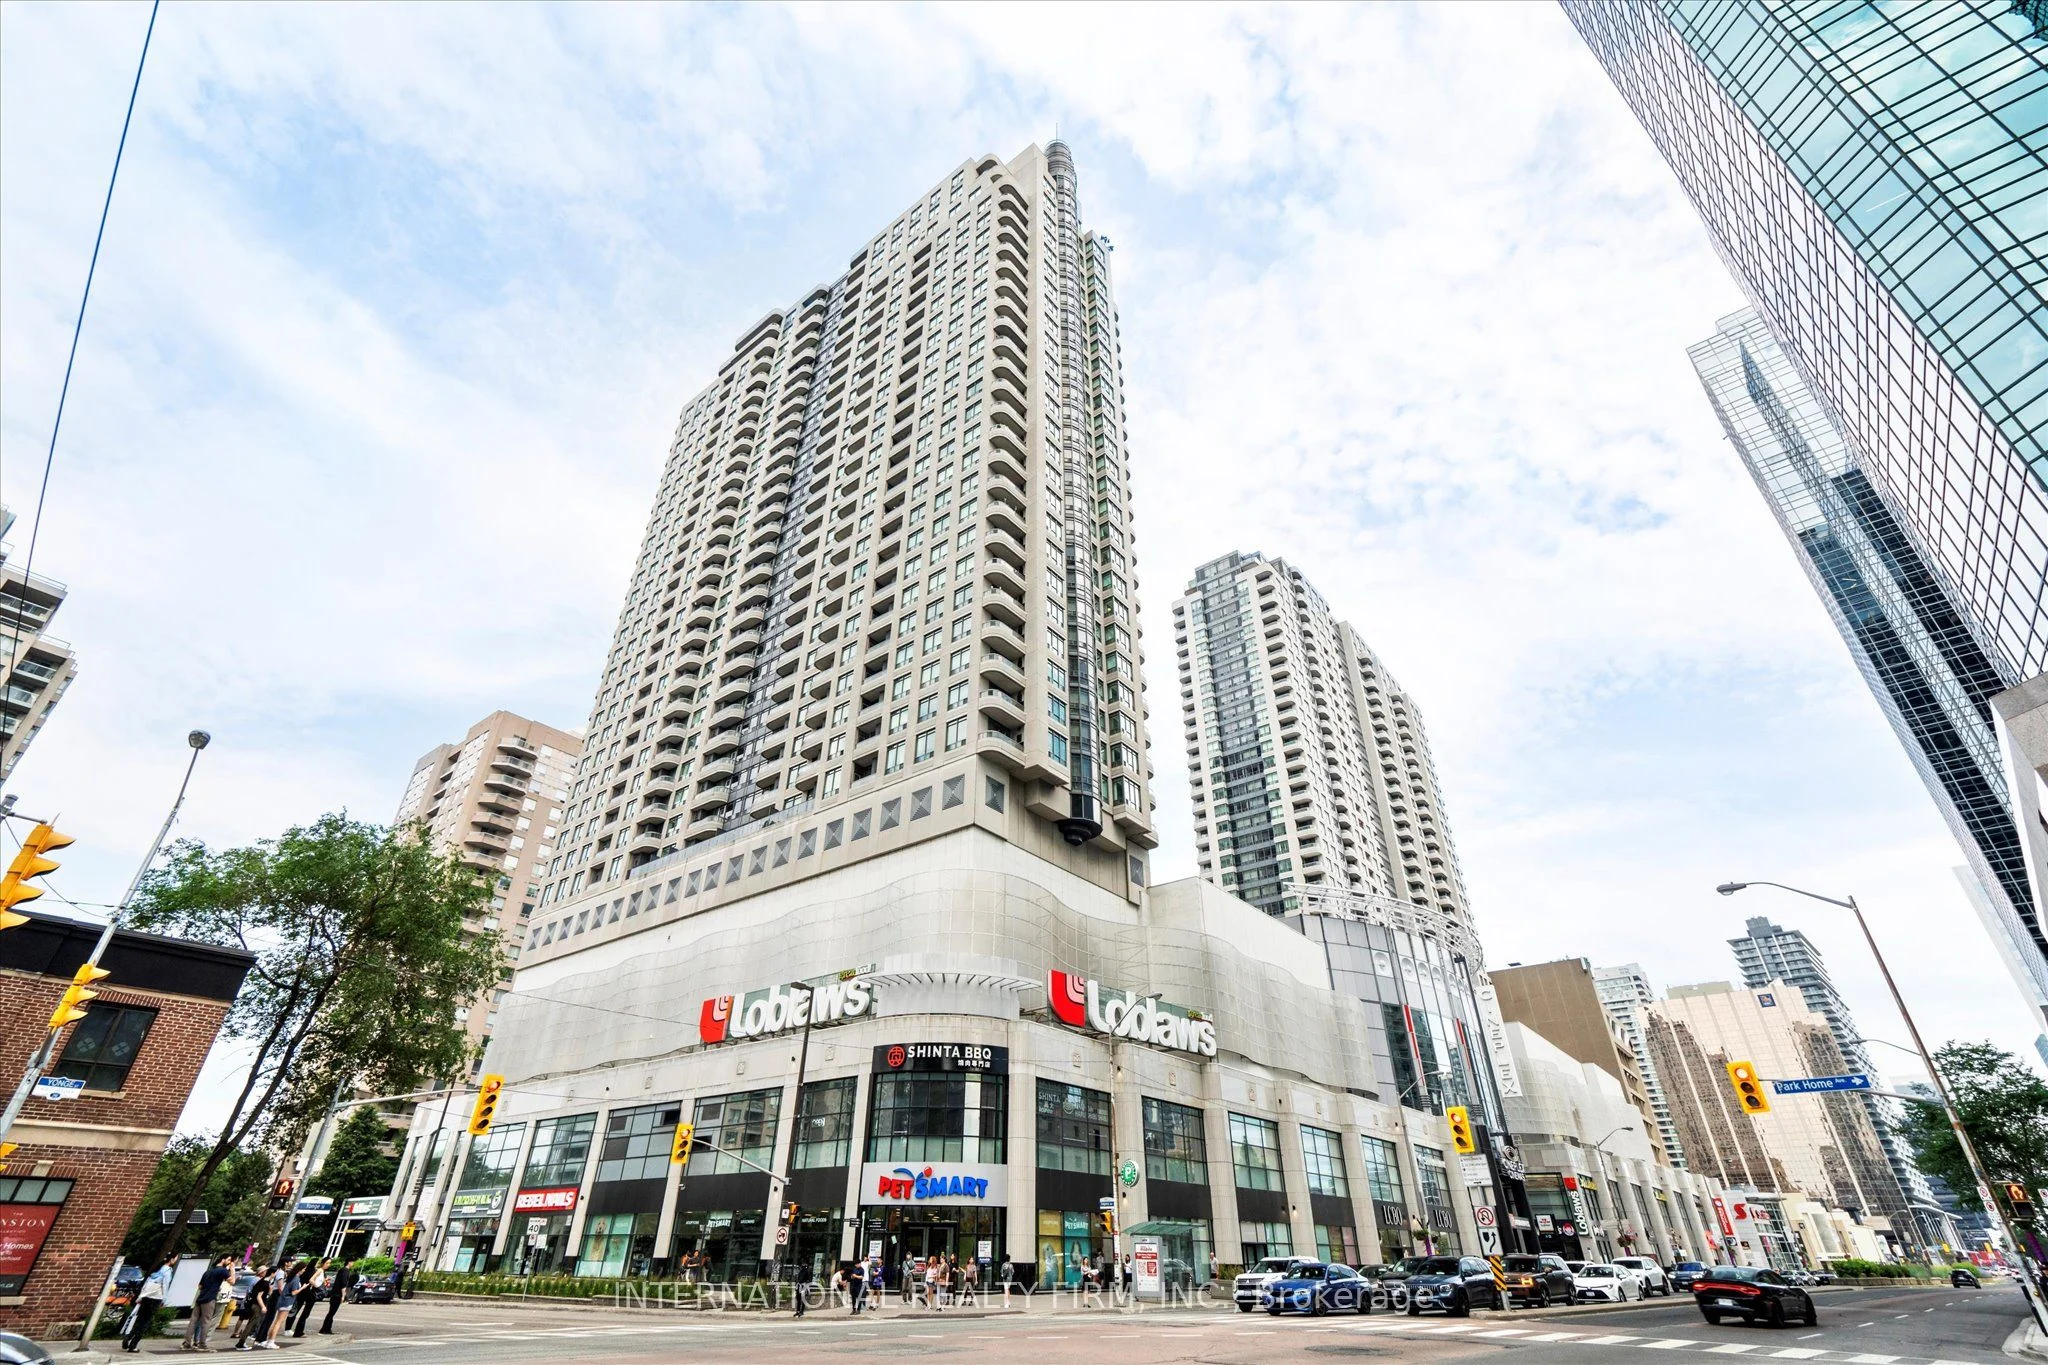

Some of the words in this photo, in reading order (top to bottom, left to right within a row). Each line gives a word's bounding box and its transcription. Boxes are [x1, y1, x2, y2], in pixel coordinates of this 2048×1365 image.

[730, 976, 872, 1038] Loblaws
[1087, 979, 1217, 1057] Loblaws
[907, 1046, 960, 1058] SHINTA
[964, 1047, 992, 1059] BBQ
[48, 1079, 75, 1088] YONGE
[1776, 1081, 1801, 1092] Park
[1802, 1080, 1833, 1090] Home
[878, 1175, 988, 1200] PETSMART
[515, 1194, 546, 1208] REBEL
[545, 1192, 576, 1206] NAILS
[1383, 1205, 1402, 1226] LCBO
[1435, 1210, 1453, 1228] LCBO
[1571, 1190, 1589, 1236] Loblaws
[528, 1224, 539, 1233] 40
